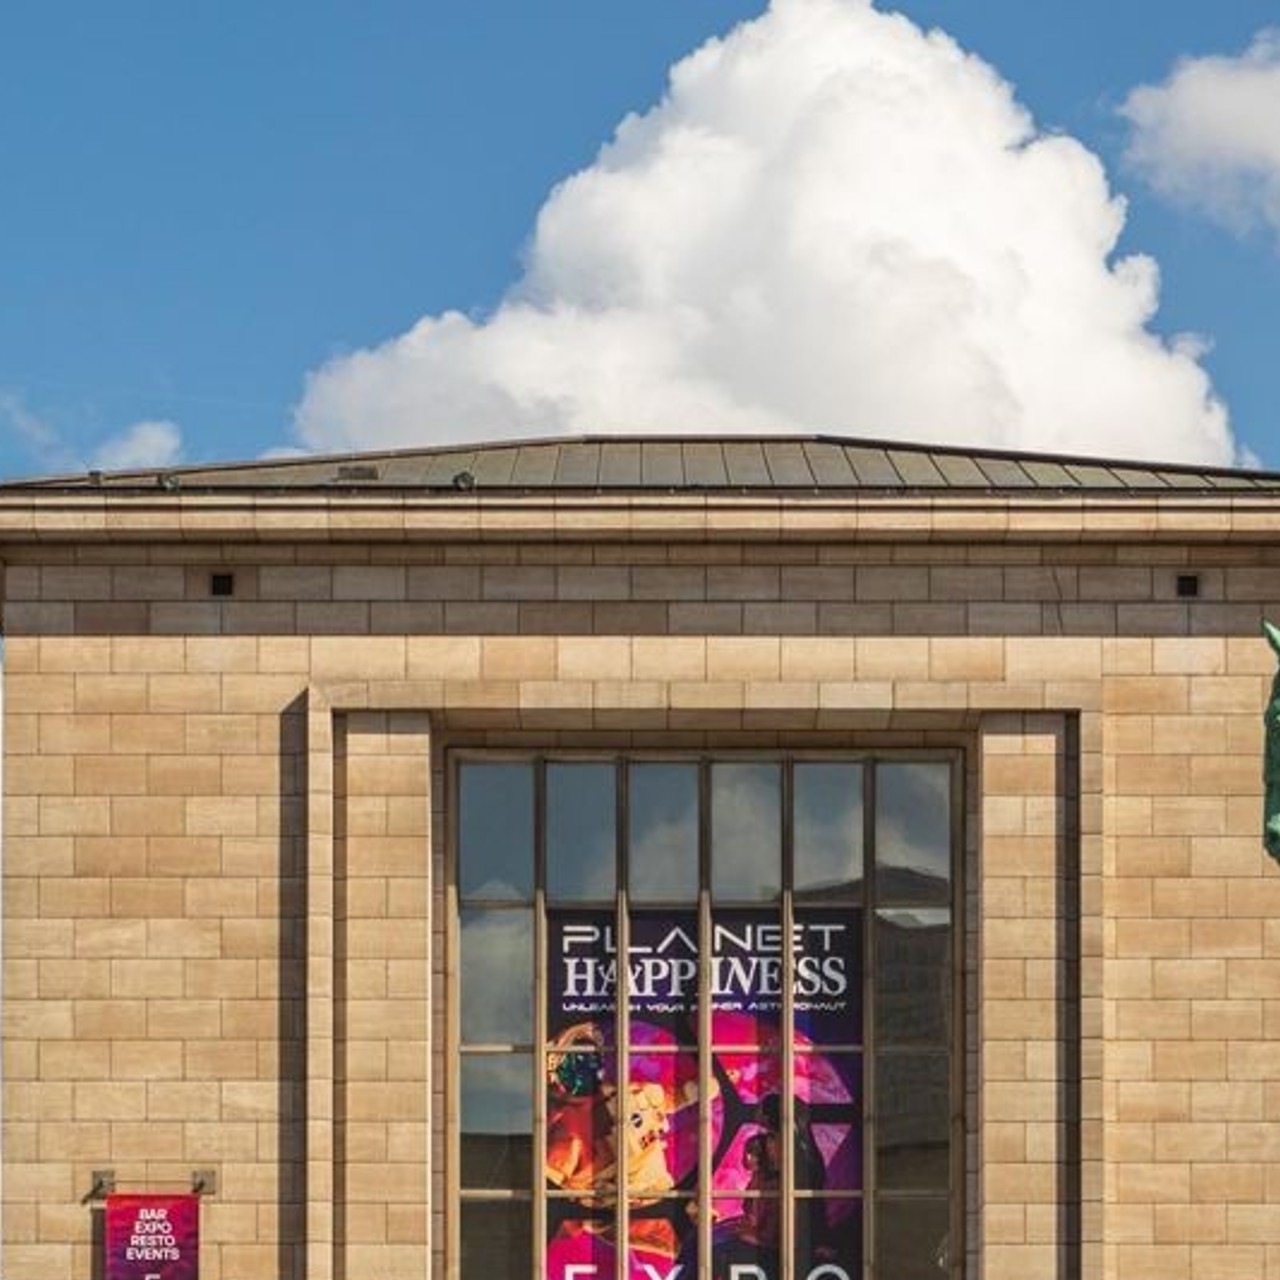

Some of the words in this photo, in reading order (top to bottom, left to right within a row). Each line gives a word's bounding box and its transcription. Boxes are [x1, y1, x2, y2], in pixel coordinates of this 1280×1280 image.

[562, 924, 846, 953] PLANET
[562, 956, 847, 997] HAPPINESS
[562, 1003, 641, 1012] UNLEAH
[138, 1208, 167, 1220] BAR
[134, 1221, 172, 1234] EXPO
[130, 1235, 176, 1247] RESTO
[126, 1249, 180, 1260] EVENTS
